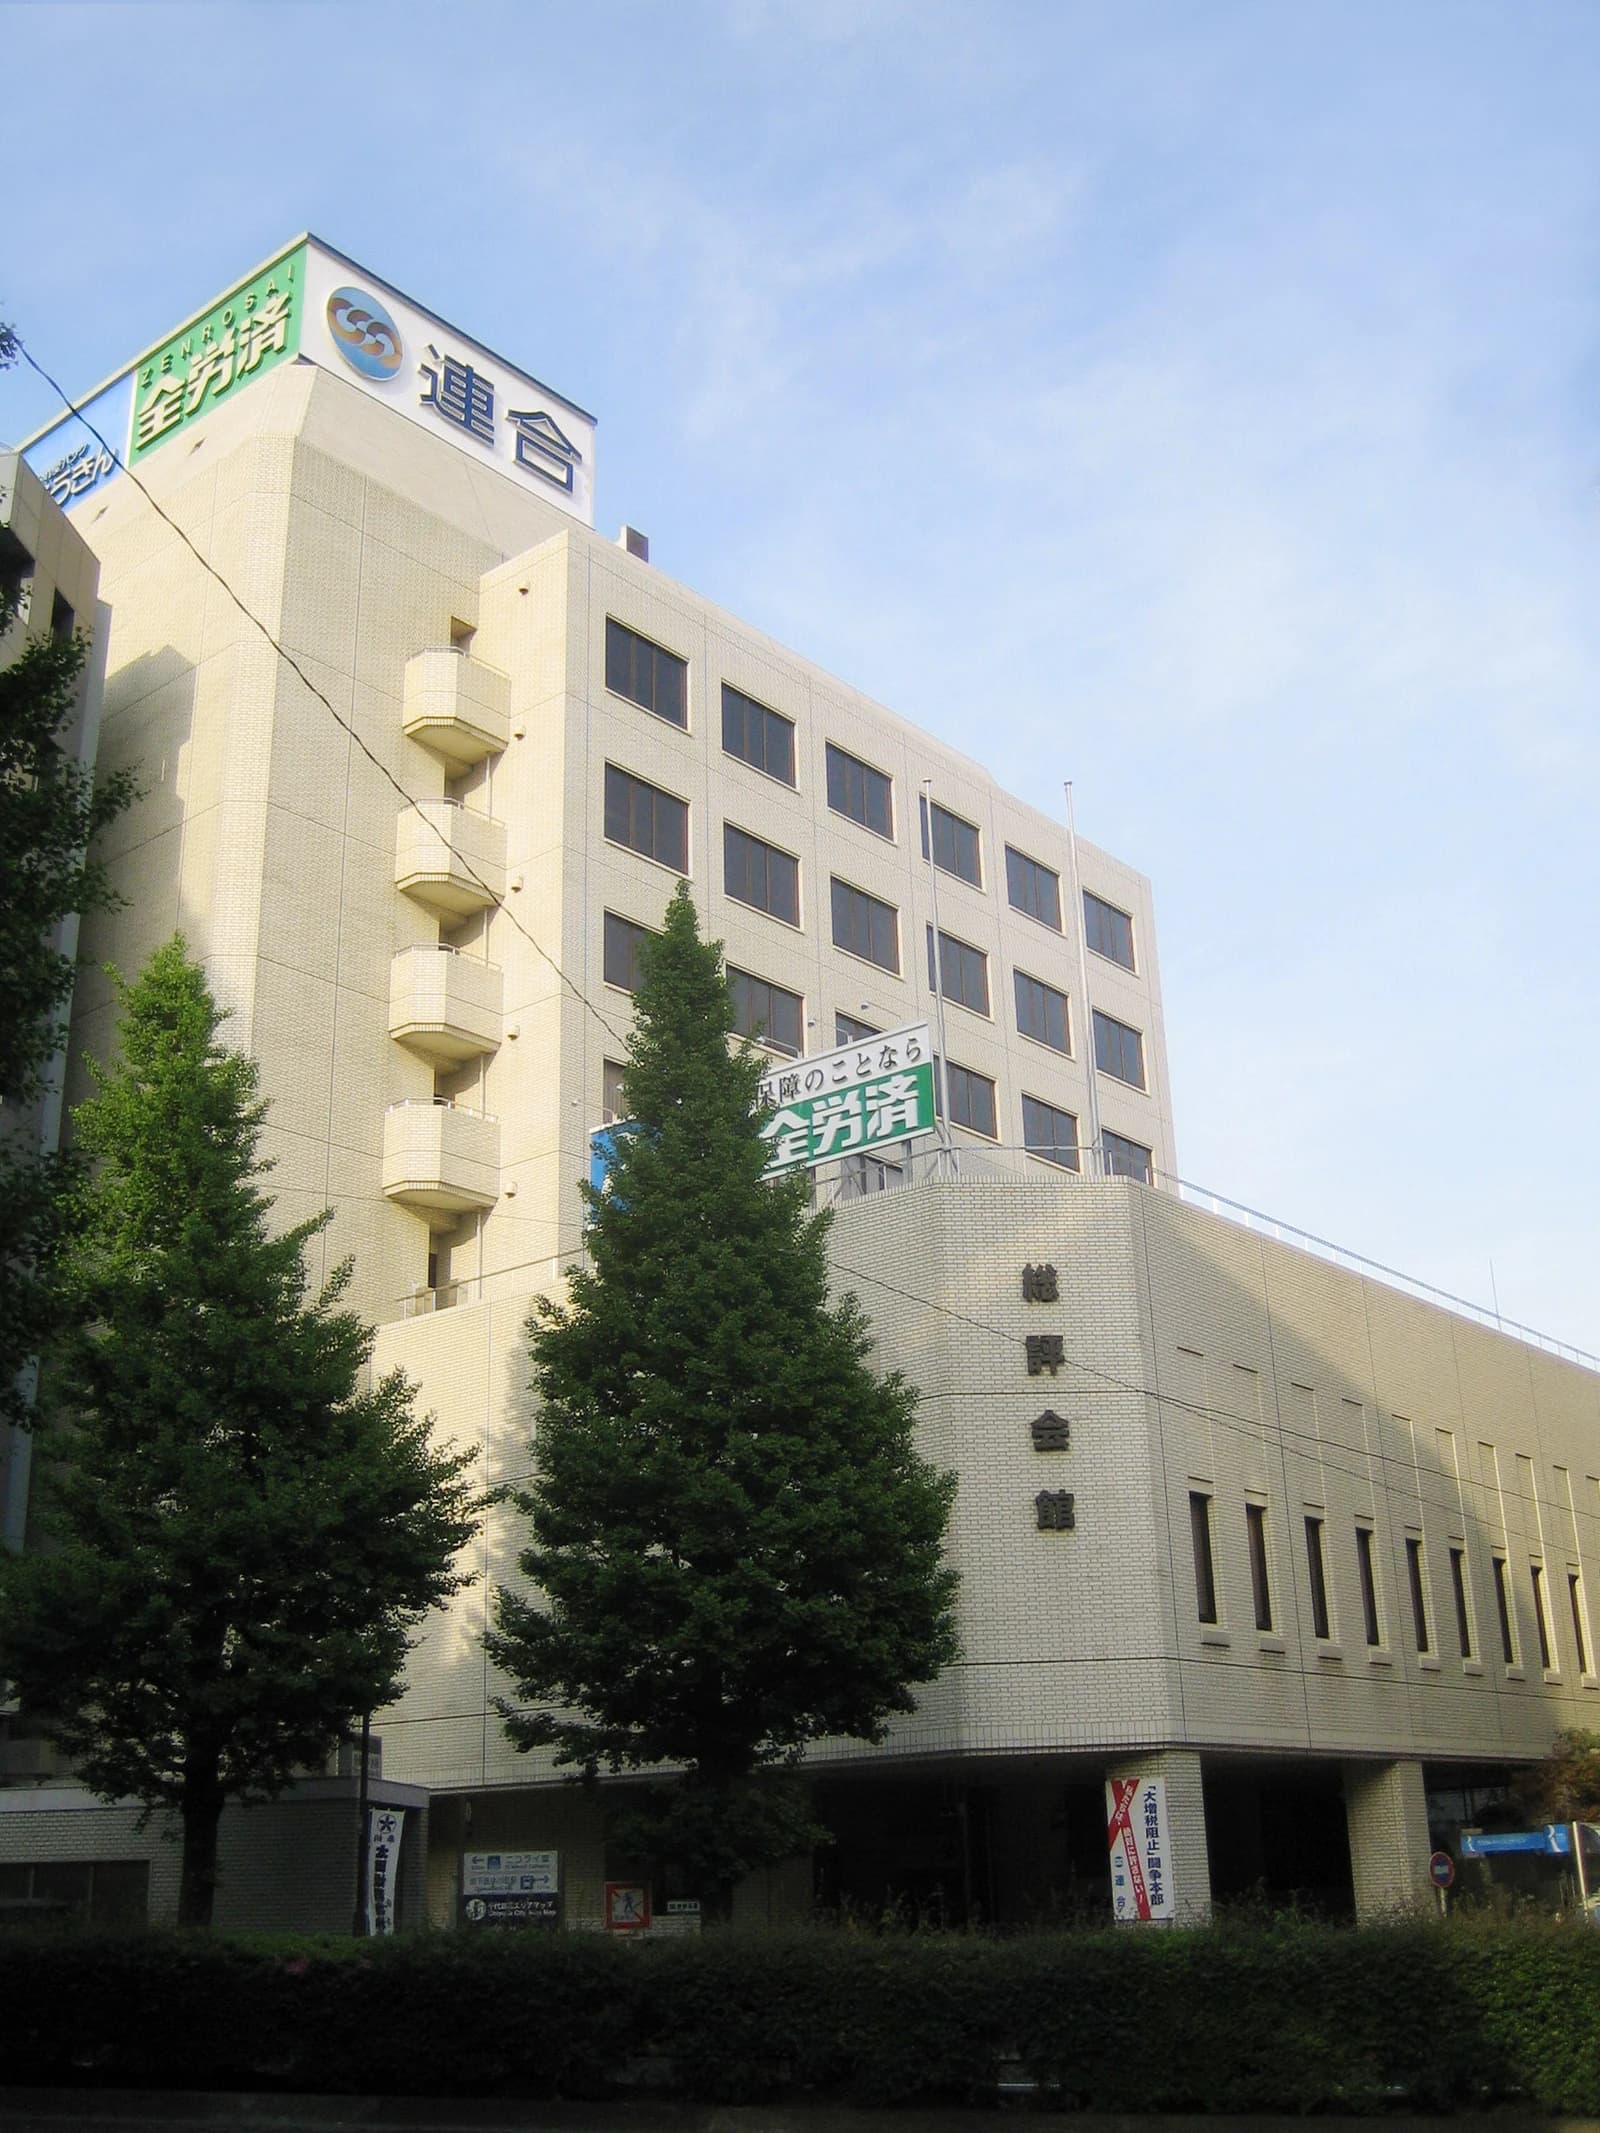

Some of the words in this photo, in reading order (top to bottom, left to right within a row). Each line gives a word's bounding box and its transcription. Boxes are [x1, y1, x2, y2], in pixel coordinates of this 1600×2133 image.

[136, 292, 291, 451] 全労済
[141, 263, 295, 389] ZENROSAI
[418, 343, 583, 495] 連合
[44, 445, 120, 507] うきん
[754, 1036, 923, 1109] 保障のことなら
[757, 1073, 919, 1167] 全労済
